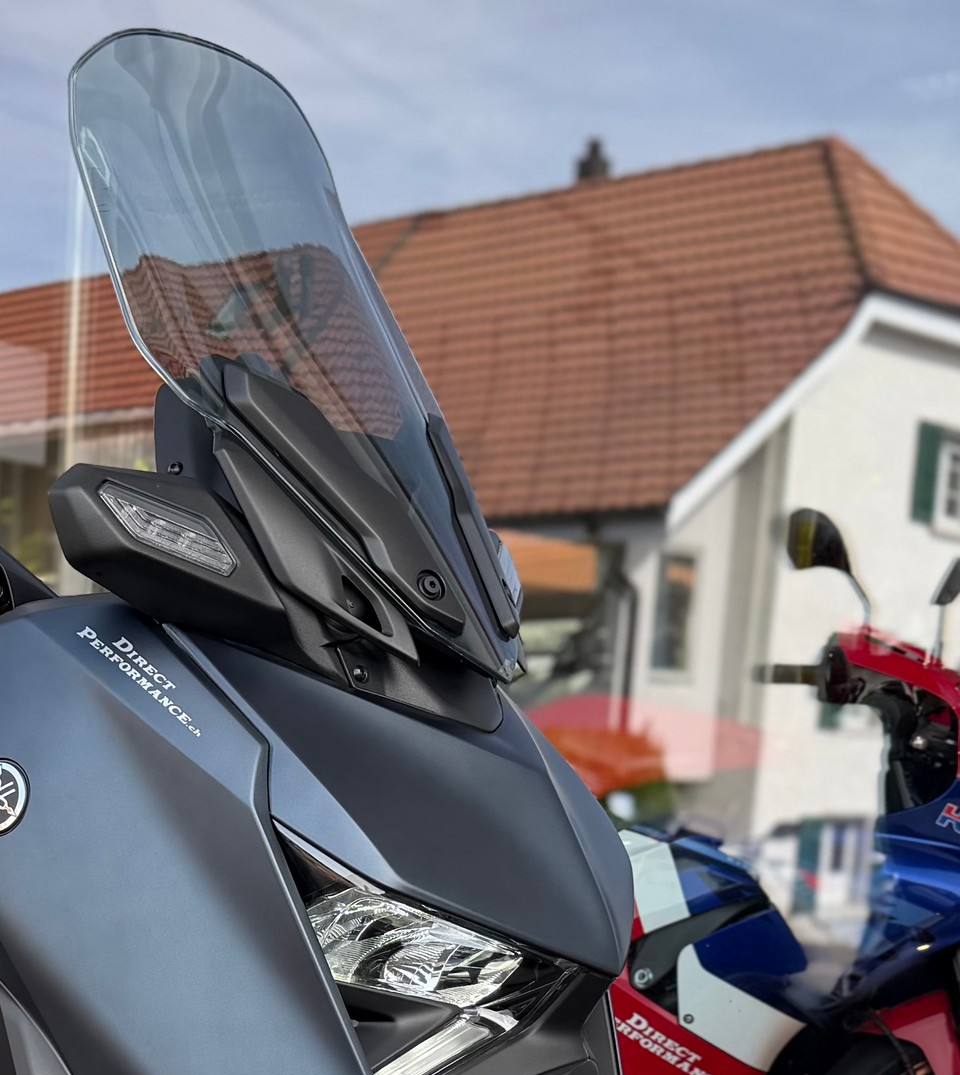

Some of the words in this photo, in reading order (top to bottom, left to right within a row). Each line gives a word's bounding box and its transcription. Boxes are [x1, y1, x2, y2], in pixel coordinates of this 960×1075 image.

[76, 625, 202, 738] PERFORMANCE.ch
[112, 636, 177, 690] DIRECT
[625, 1011, 703, 1065] DIRECT
